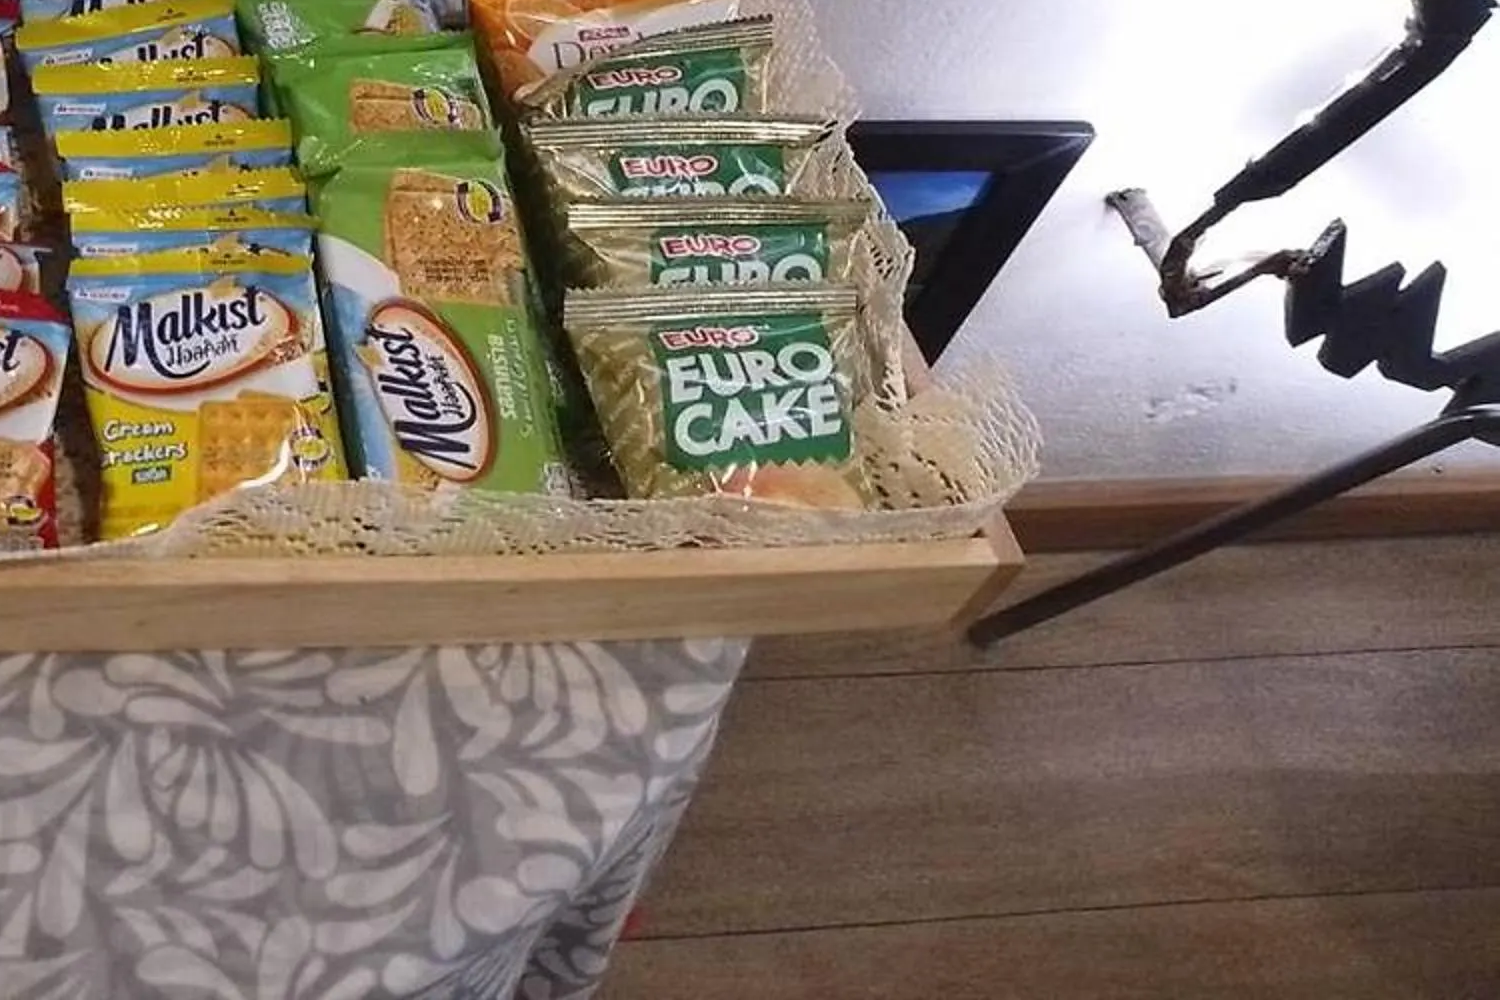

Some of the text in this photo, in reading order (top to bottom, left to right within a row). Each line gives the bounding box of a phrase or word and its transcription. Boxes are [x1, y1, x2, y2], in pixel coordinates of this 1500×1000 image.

[590, 67, 682, 89] EURO
[621, 155, 717, 178] EURO
[660, 235, 761, 257] EURO
[105, 285, 268, 380] Malkist
[660, 326, 759, 349] EURO
[666, 342, 834, 403] EURO
[363, 322, 478, 470] Malkist
[103, 420, 175, 442] Cream
[674, 384, 843, 456] CAKE
